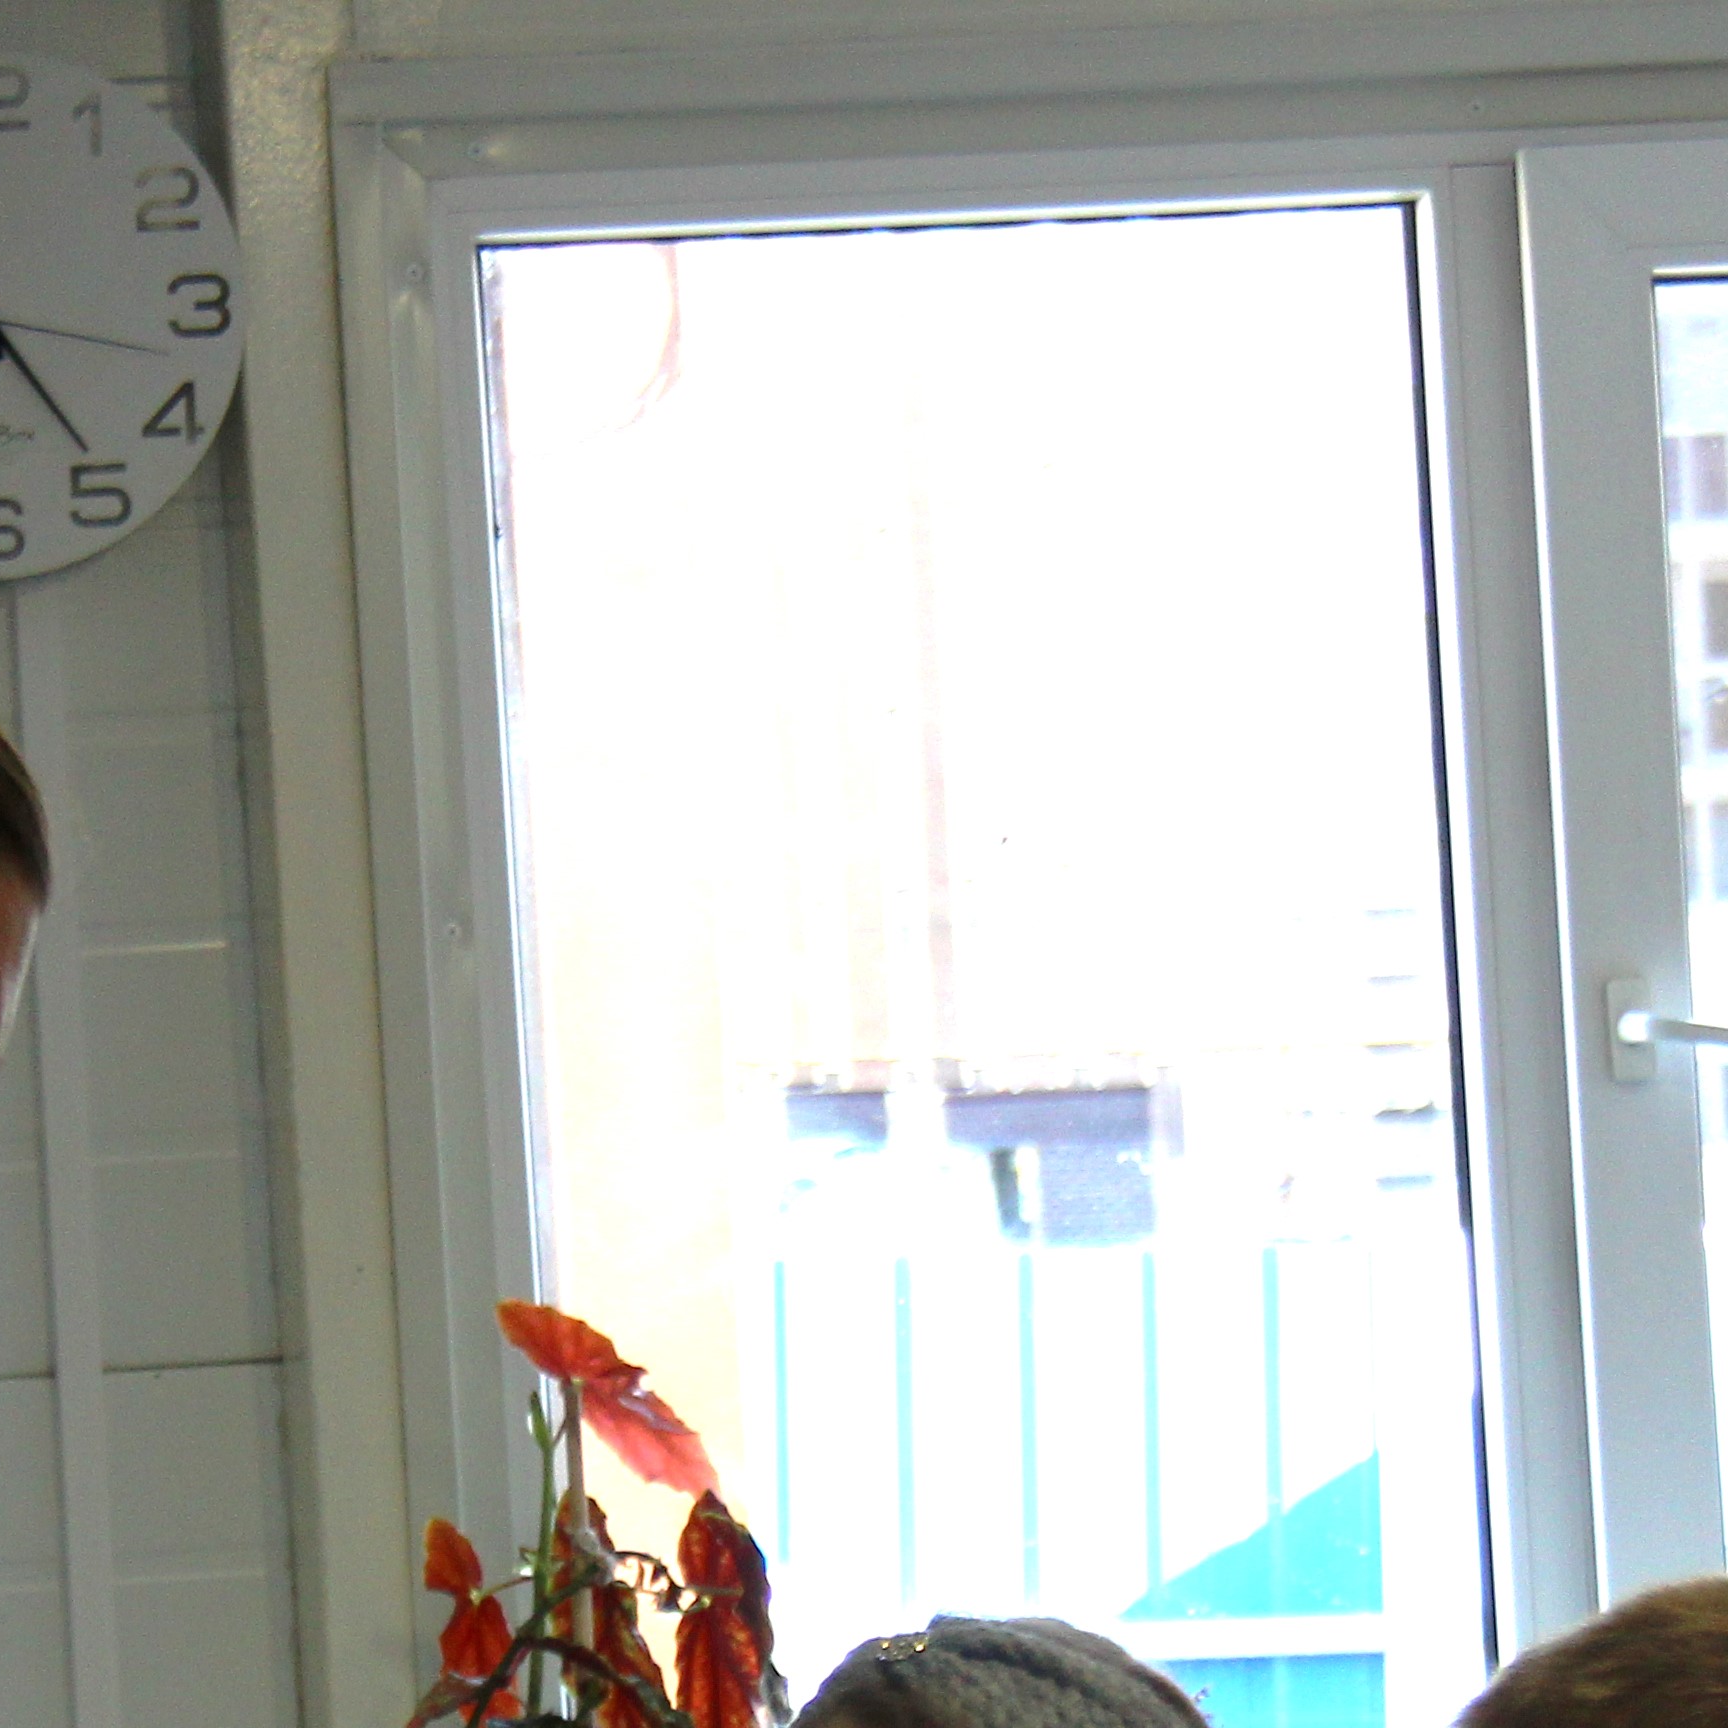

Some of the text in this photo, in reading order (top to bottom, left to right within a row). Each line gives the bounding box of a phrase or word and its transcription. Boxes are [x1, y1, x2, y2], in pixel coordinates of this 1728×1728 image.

[72, 94, 104, 156] 1
[136, 167, 199, 232] 2
[168, 273, 231, 337] 3
[141, 381, 204, 445] 4
[70, 463, 131, 527] 5
